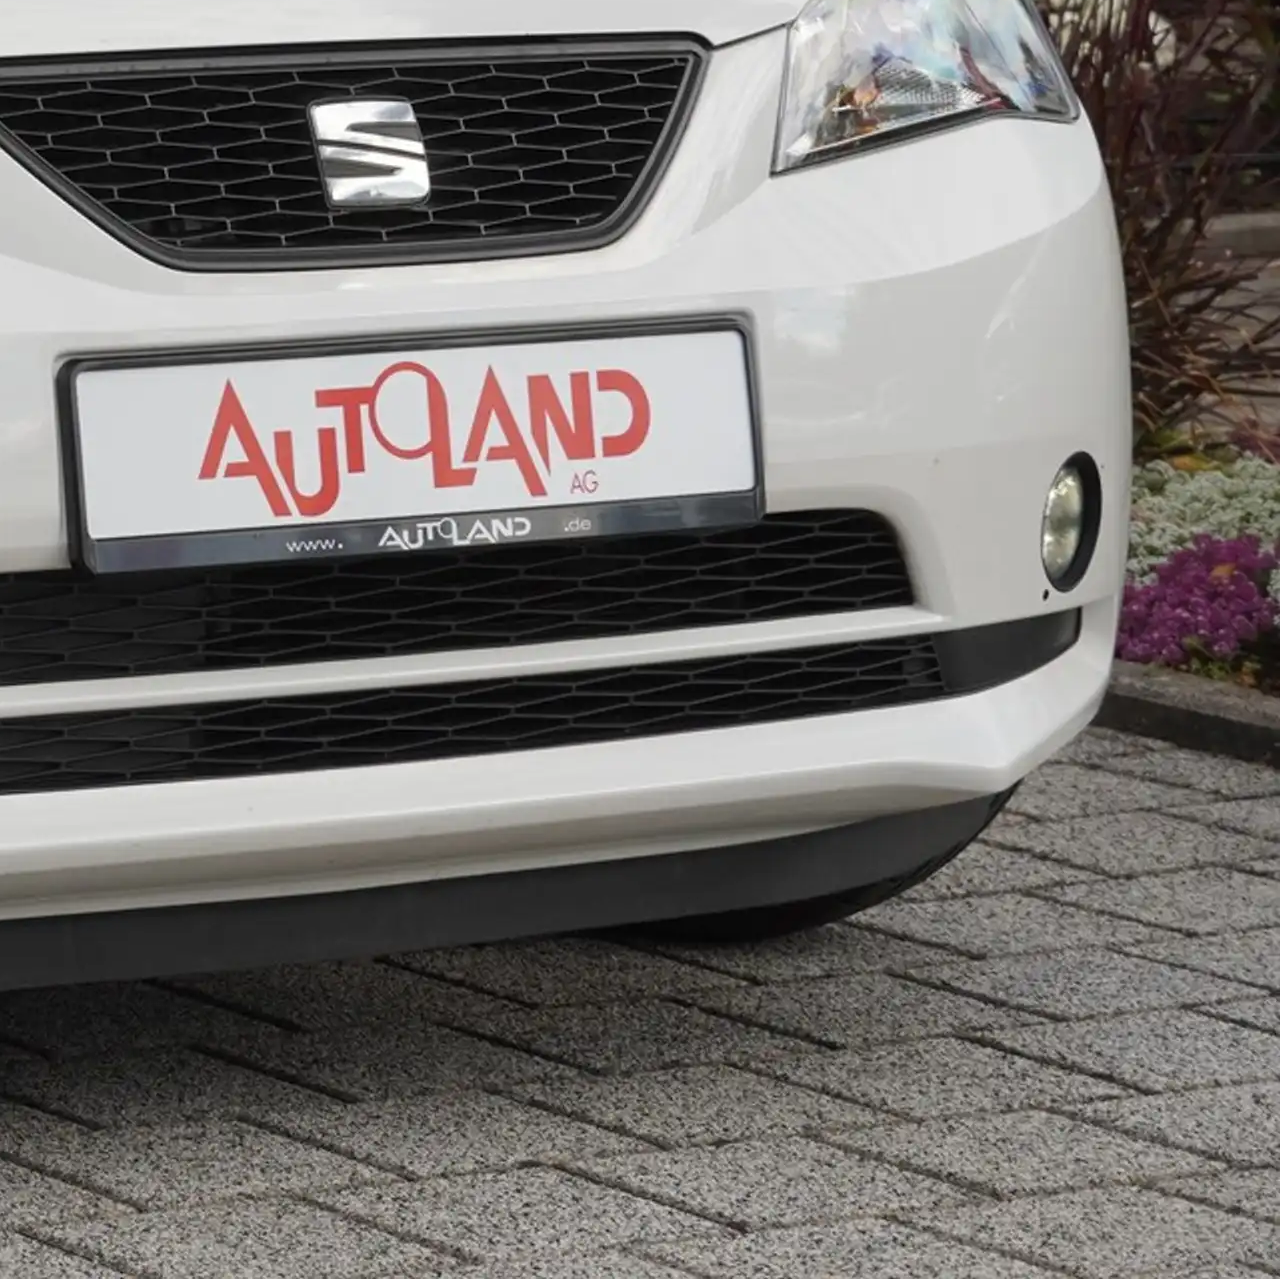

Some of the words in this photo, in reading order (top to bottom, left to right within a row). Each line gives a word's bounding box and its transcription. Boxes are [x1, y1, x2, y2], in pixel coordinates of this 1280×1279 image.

[197, 360, 652, 518] AUTOLAND
[569, 470, 600, 494] AG
[285, 537, 344, 553] www.
[378, 517, 532, 550] AUTOLAND
[563, 517, 592, 533] .de
